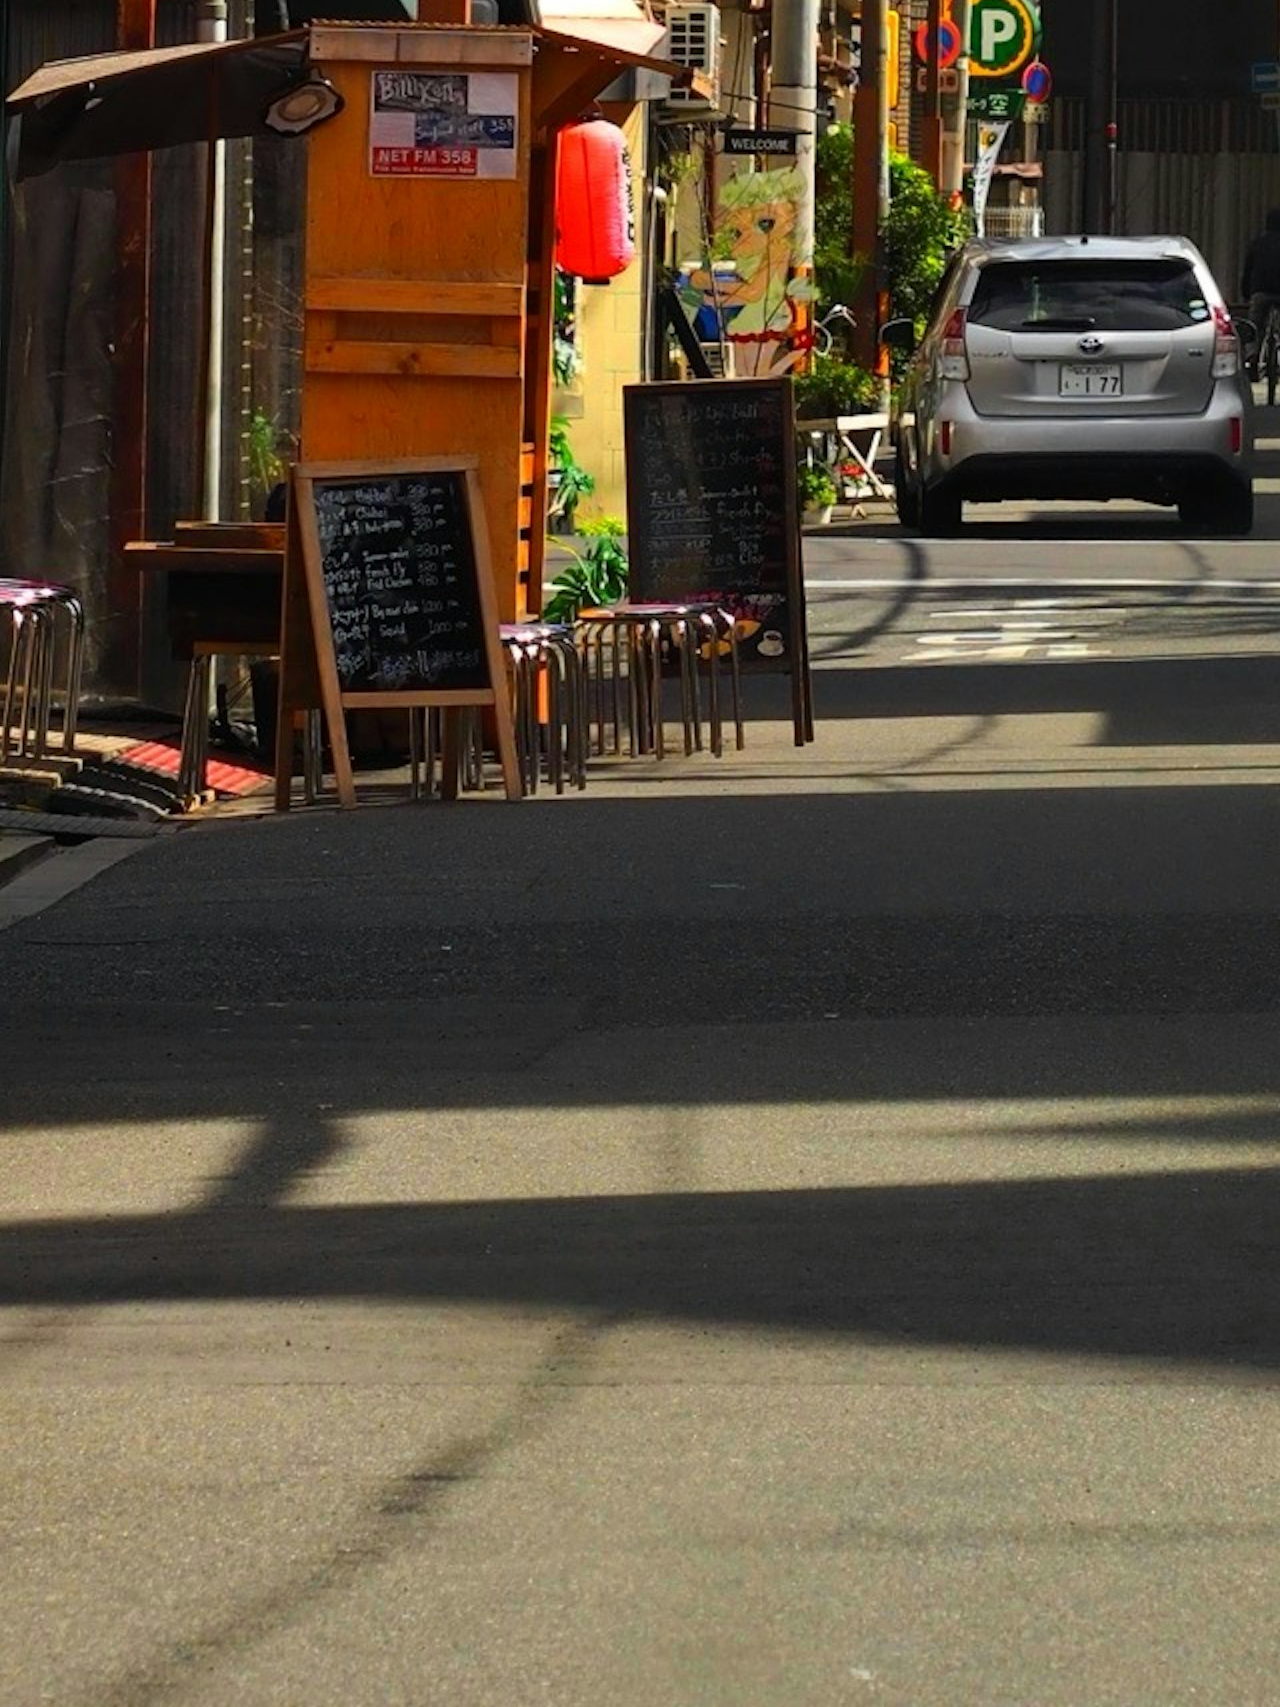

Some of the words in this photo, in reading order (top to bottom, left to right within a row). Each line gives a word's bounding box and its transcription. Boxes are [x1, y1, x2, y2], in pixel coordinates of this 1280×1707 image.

[981, 8, 1017, 62] P
[988, 93, 1010, 116] 空
[730, 137, 788, 151] WELCOME
[379, 149, 409, 163] NET
[414, 150, 437, 164] FM
[440, 150, 472, 165] 358
